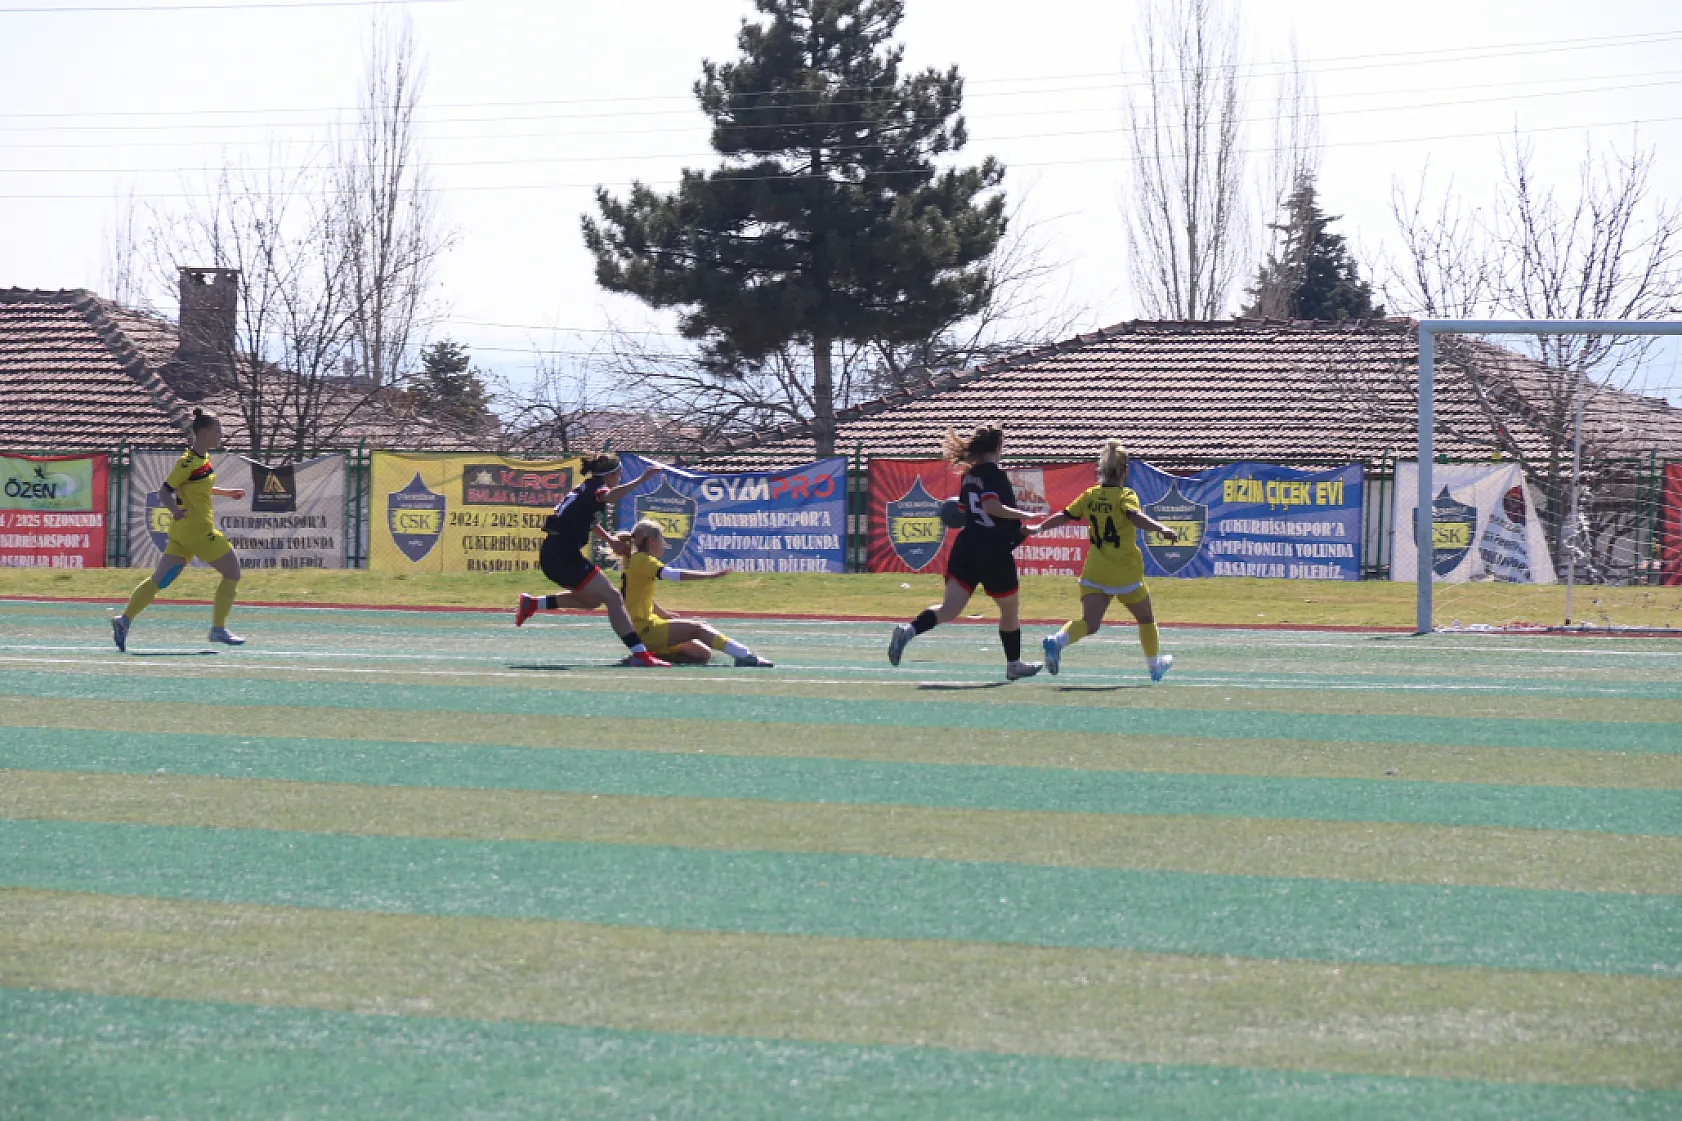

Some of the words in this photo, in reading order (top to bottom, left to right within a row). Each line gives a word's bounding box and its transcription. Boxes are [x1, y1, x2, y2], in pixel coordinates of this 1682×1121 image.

[5, 477, 56, 499] ÖZEN
[701, 475, 835, 501] GYMPRO
[1266, 477, 1311, 511] ÇİÇEK
[1315, 477, 1344, 506] EVİ
[967, 491, 996, 526] 5
[16, 514, 40, 527] 2025
[400, 513, 430, 534] ÇSK
[450, 512, 479, 527] 2024
[491, 512, 519, 528] 2025
[708, 510, 832, 531] ÇUKURHİSARSPOR'A
[1219, 518, 1346, 537] ÇUKURHİSARSPOR'A
[902, 522, 932, 541] ÇSK
[1090, 515, 1120, 549] 14
